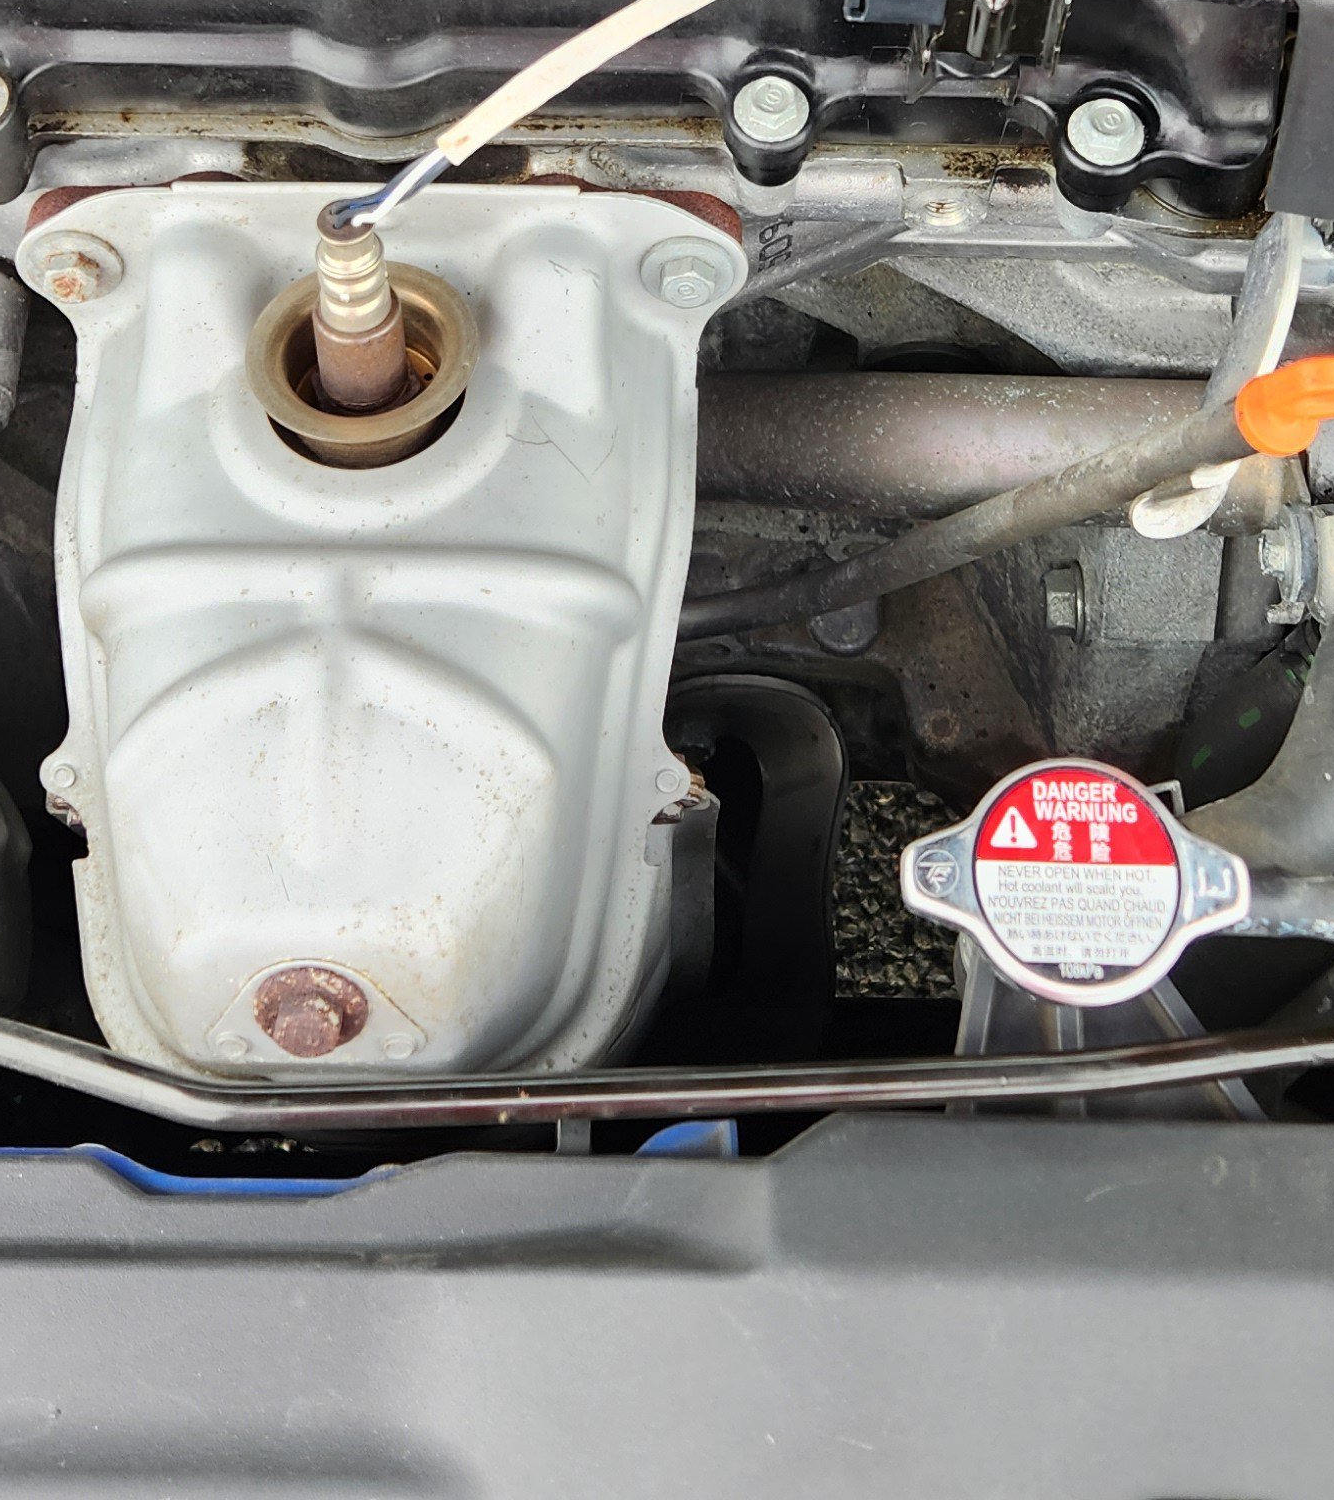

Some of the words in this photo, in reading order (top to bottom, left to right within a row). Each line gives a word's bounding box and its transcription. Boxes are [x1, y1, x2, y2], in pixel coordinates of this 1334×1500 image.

[1031, 780, 1118, 804] DANGER
[1033, 800, 1138, 824] WARNUNG
[998, 865, 1041, 879] NEVER
[1044, 866, 1080, 880] OPEN
[1084, 867, 1122, 881] WHEN
[998, 880, 1019, 893] Hot
[1021, 880, 1062, 893] coolant
[1066, 881, 1083, 894] will
[1086, 882, 1115, 895] scald
[1119, 885, 1142, 897] you.
[988, 894, 1048, 909] N'OUVREZ
[1051, 896, 1074, 910] PAS
[1078, 897, 1120, 912] QUAND
[993, 911, 1022, 925] NICHT
[1024, 912, 1040, 926] BEI
[1042, 913, 1084, 927] HEISSEM
[1086, 914, 1121, 928] MOTOR
